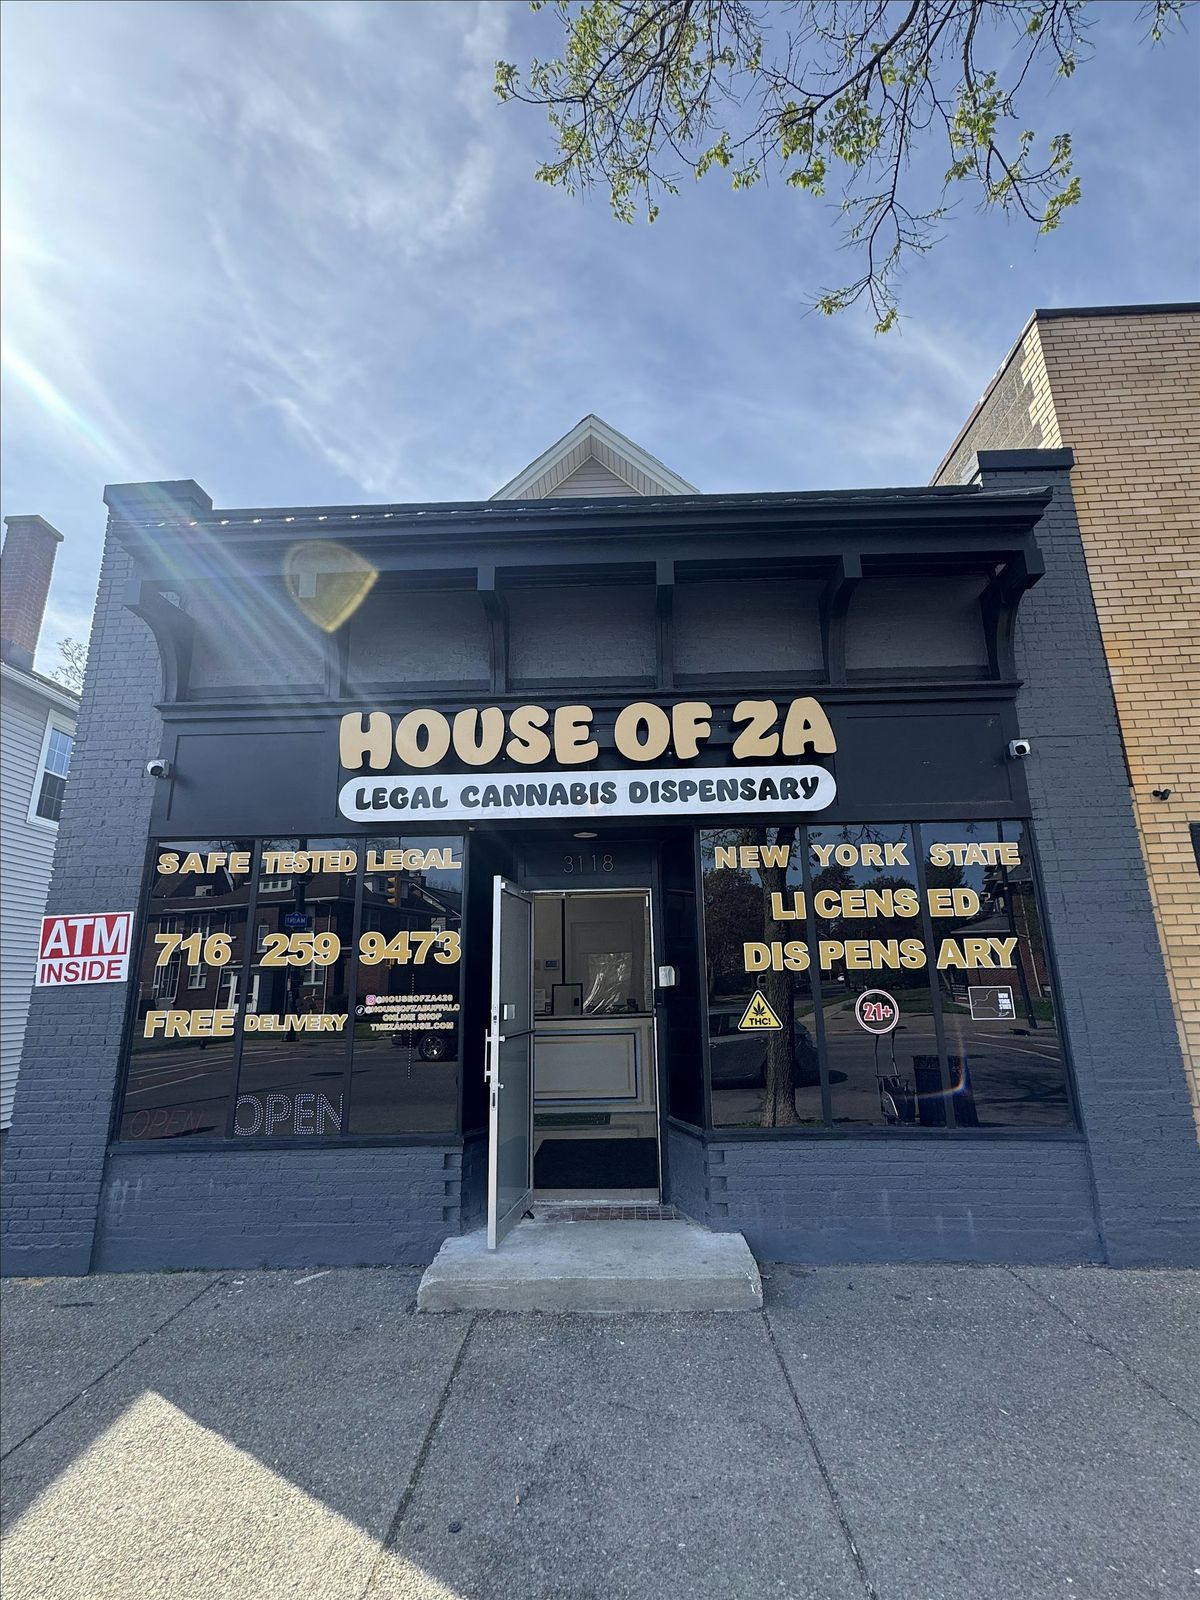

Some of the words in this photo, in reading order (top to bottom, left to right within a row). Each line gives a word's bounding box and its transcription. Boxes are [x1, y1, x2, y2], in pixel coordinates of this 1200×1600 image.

[339, 704, 599, 770] HOUSE
[614, 701, 713, 762] OF
[732, 696, 838, 759] ZA
[355, 786, 449, 810] LEGAL
[459, 780, 618, 808] CANNABIS
[628, 776, 820, 804] DISPENSARY
[157, 852, 251, 874] SAFE
[262, 850, 358, 874] TESTED
[366, 848, 461, 872] LEGAL
[563, 854, 614, 873] 3118
[714, 845, 790, 869] NEW
[811, 843, 910, 867] YORK
[929, 842, 1021, 867] STATE
[42, 916, 128, 958] ATM
[154, 932, 232, 967] 716
[259, 931, 341, 967] 259
[358, 930, 462, 966] 9473
[40, 959, 122, 984] INSIDE
[144, 1009, 236, 1038] FREE
[243, 1013, 349, 1032] DELIVERY
[382, 1013, 416, 1022] ONLINE
[417, 1012, 443, 1021] SHOP
[748, 1017, 771, 1026] THC!
[862, 1001, 894, 1022] 21+
[234, 1093, 344, 1136] OPEN
